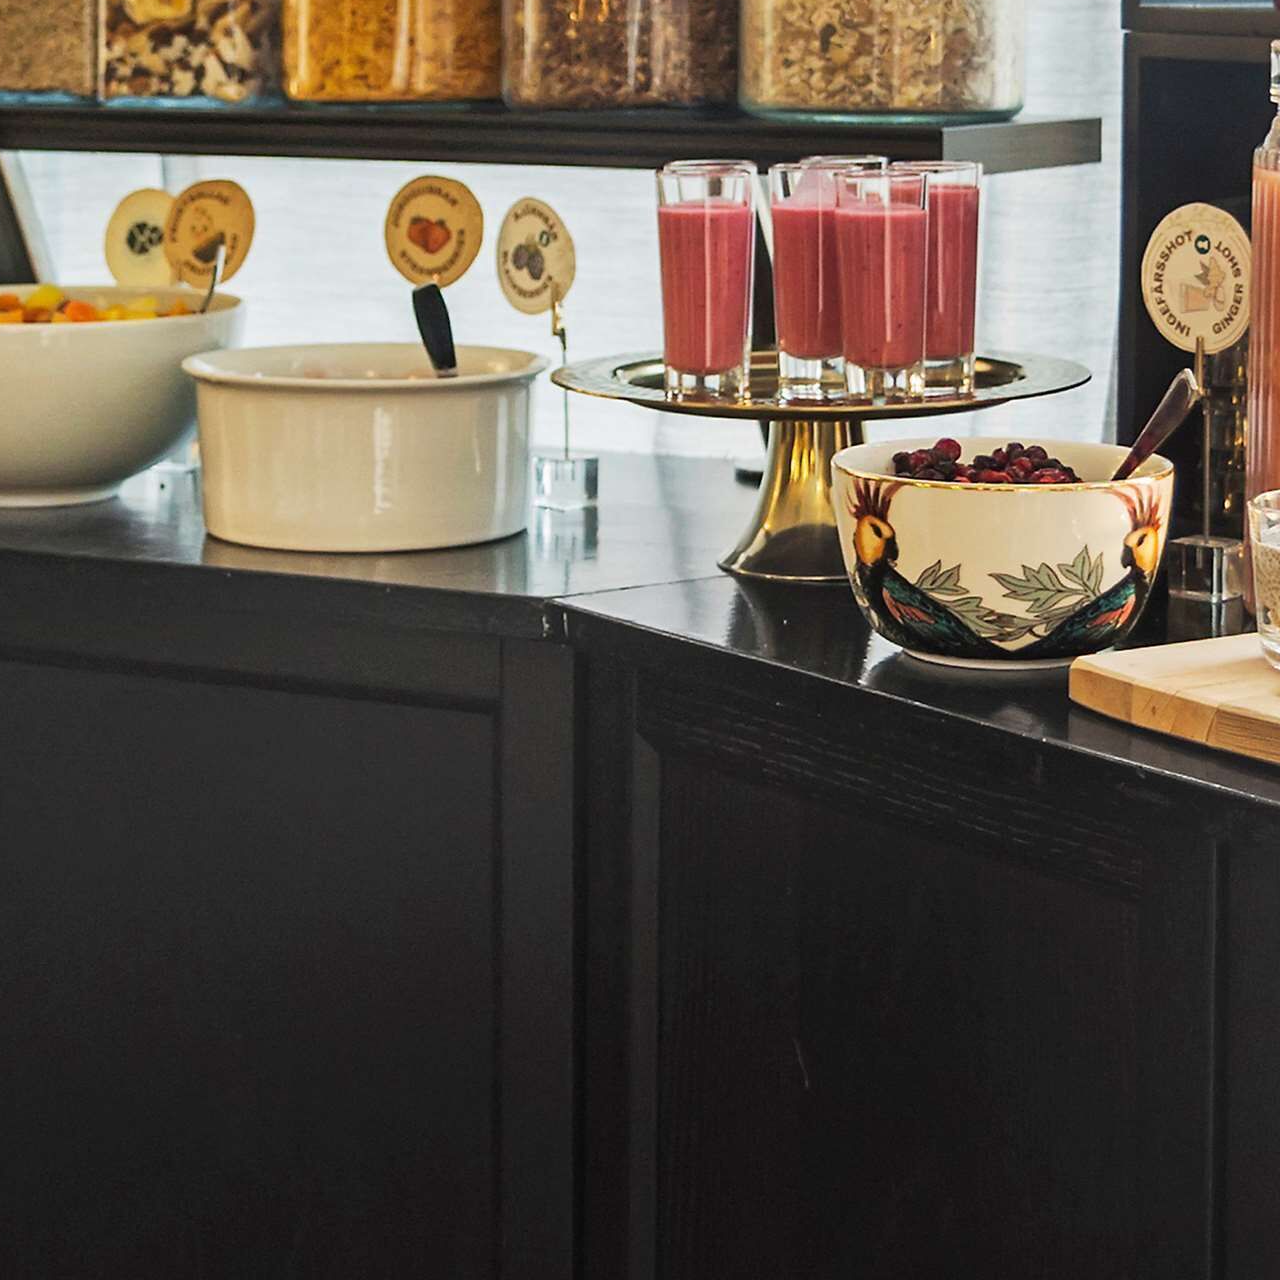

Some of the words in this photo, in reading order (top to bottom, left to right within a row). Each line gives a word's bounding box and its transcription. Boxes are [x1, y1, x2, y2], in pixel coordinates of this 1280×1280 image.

[1151, 230, 1193, 337] INGEFÄRSSHOT
[1214, 241, 1242, 278] SHOT
[1212, 283, 1244, 335] GINGER
